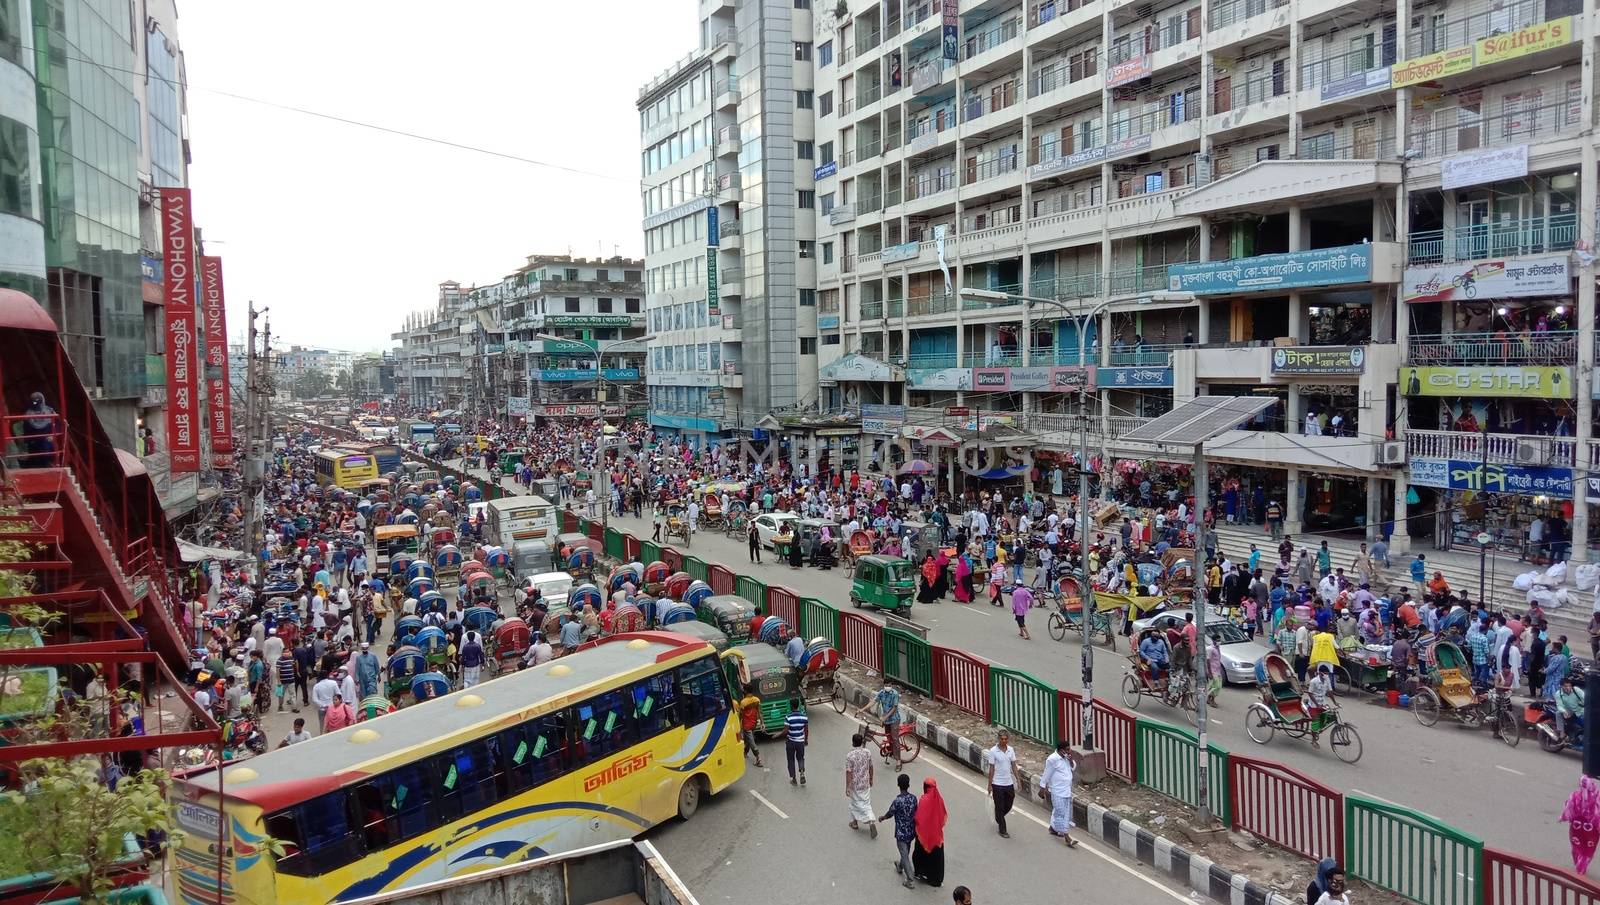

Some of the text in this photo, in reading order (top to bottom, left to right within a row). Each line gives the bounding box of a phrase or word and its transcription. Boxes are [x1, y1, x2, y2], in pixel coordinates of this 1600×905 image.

[1484, 24, 1562, 57] S@ifur's
[167, 196, 188, 305] SYMPHONY
[206, 262, 222, 337] SYMPHONY
[170, 318, 191, 447] মুক্তিযোদ্ধা হক প্লাজা
